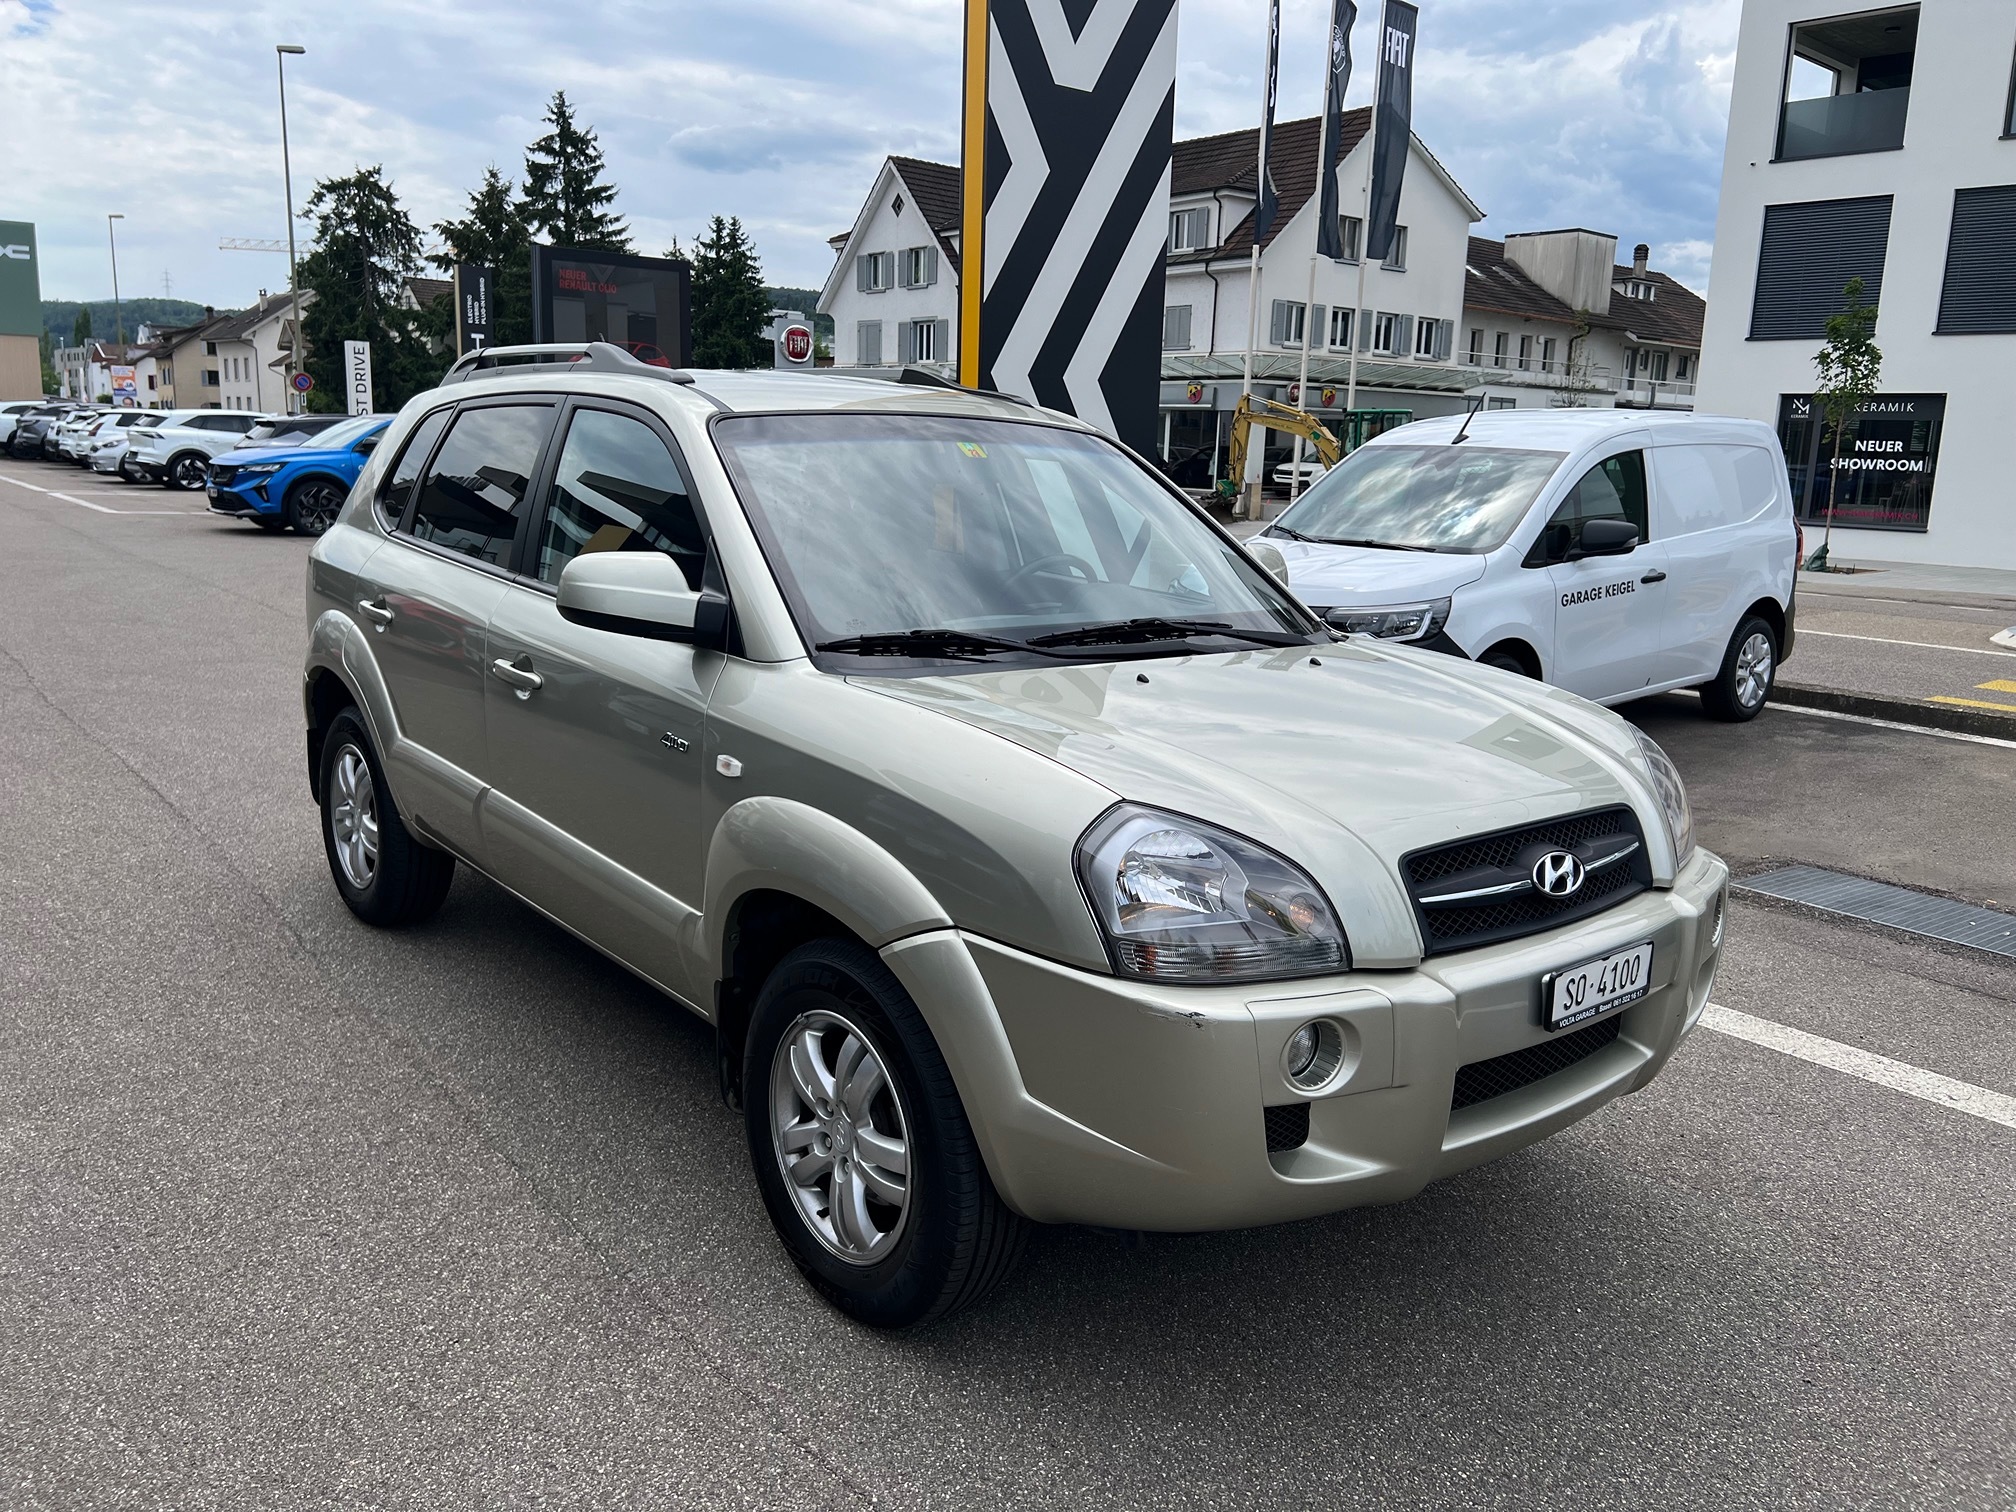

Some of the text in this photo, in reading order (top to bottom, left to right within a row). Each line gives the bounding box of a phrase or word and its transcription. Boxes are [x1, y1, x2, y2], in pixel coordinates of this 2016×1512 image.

[1385, 26, 1410, 68] FIAT
[559, 268, 587, 281] NEUER
[559, 279, 617, 294] RENAULT CLIO
[789, 335, 809, 353] FIAT
[353, 346, 367, 393] DRIVE
[1853, 402, 1915, 412] KERAMIK
[1855, 440, 1904, 452] NEUER
[1829, 458, 1924, 472] SHOWROOM
[1561, 580, 1635, 607] GARAGE KEIGEL
[1560, 1017, 1575, 1028] VOLTA
[1575, 1007, 1596, 1021] GARAGE
